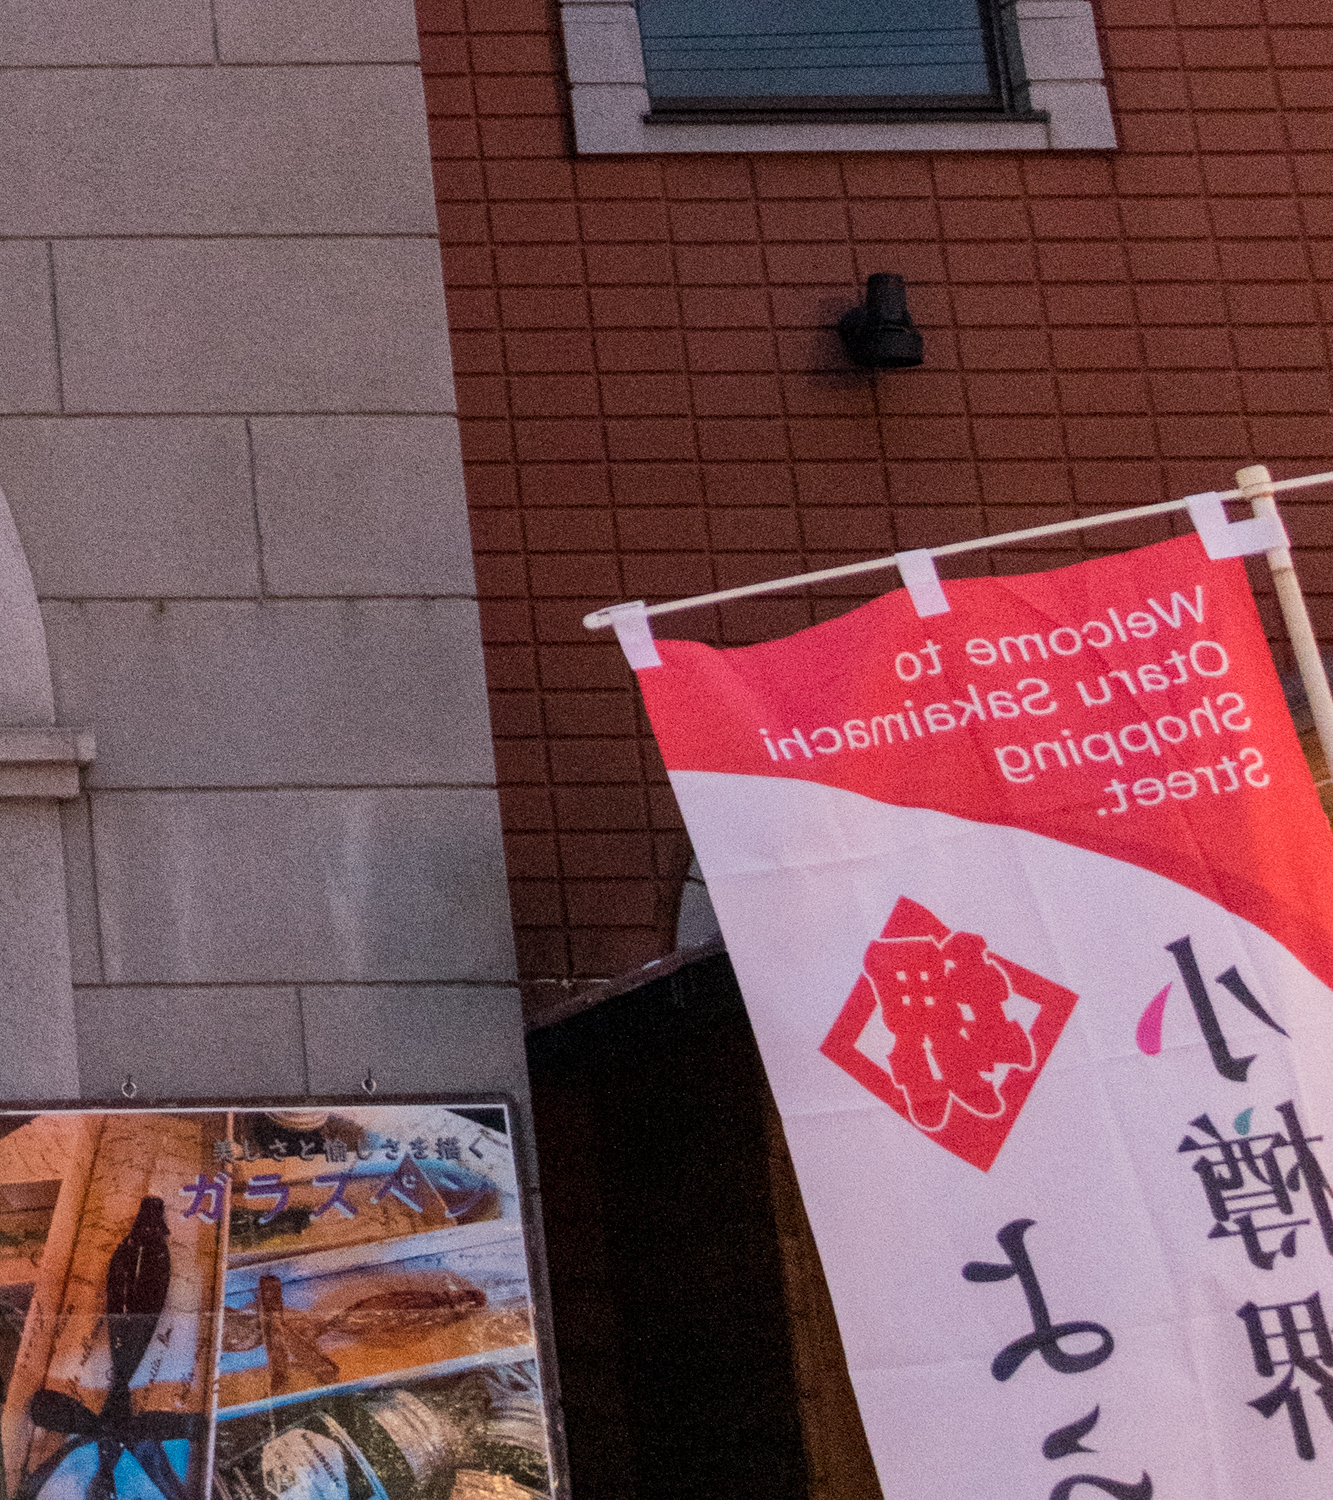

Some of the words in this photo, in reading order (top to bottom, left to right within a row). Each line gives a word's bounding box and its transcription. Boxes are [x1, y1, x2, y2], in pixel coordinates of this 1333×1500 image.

[178, 1170, 489, 1225] ガラスペン
